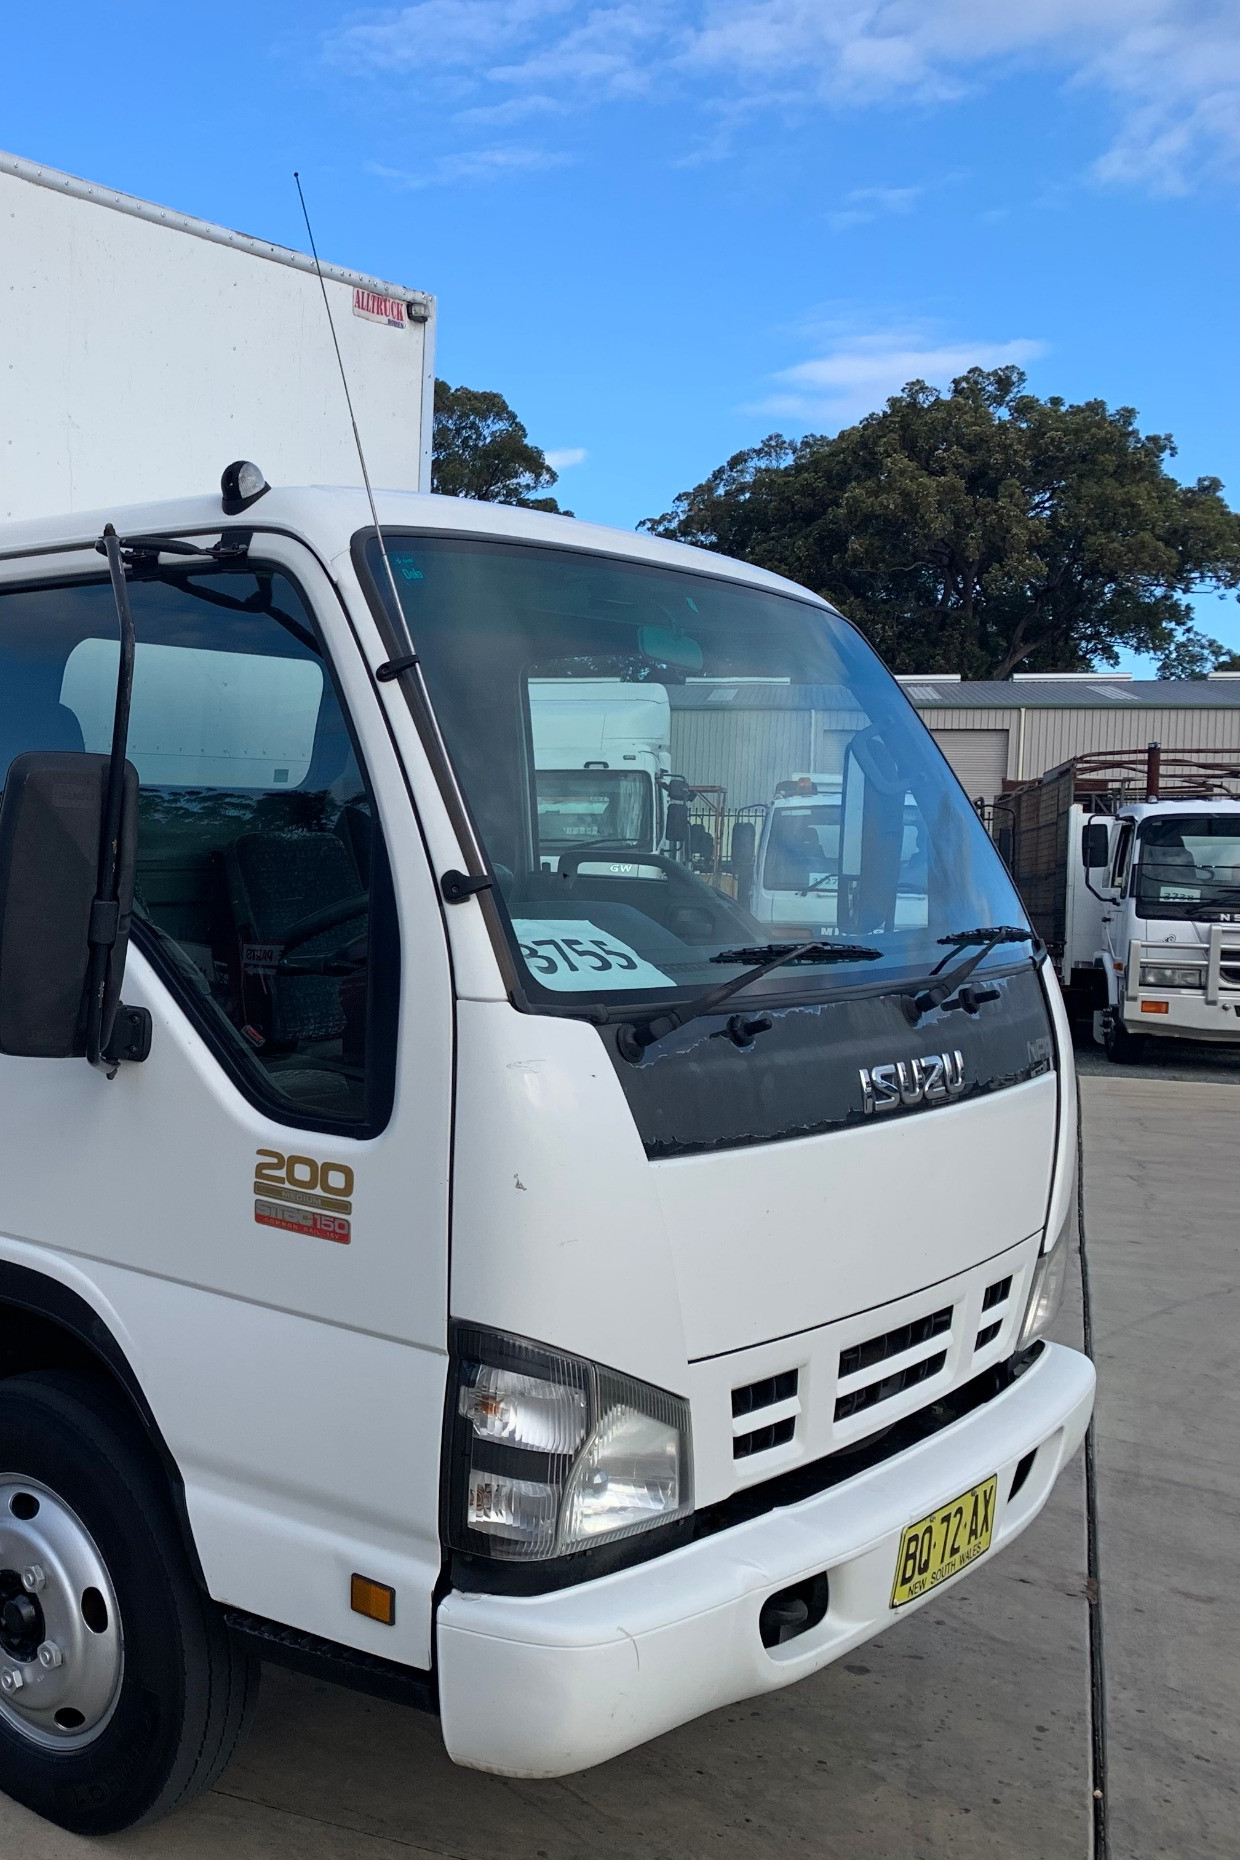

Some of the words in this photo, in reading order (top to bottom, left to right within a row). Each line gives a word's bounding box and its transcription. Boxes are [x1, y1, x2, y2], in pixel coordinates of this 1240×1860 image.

[354, 290, 404, 322] ALLTRUCK
[610, 864, 632, 873] GW
[859, 1049, 966, 1114] ISUZU
[255, 1148, 354, 1198] 200
[281, 1190, 322, 1206] MEDIUM
[314, 1213, 349, 1235] 150
[907, 1577, 928, 1598] NEW
[931, 1558, 956, 1585] SOUTH
[959, 1541, 982, 1566] WALES
